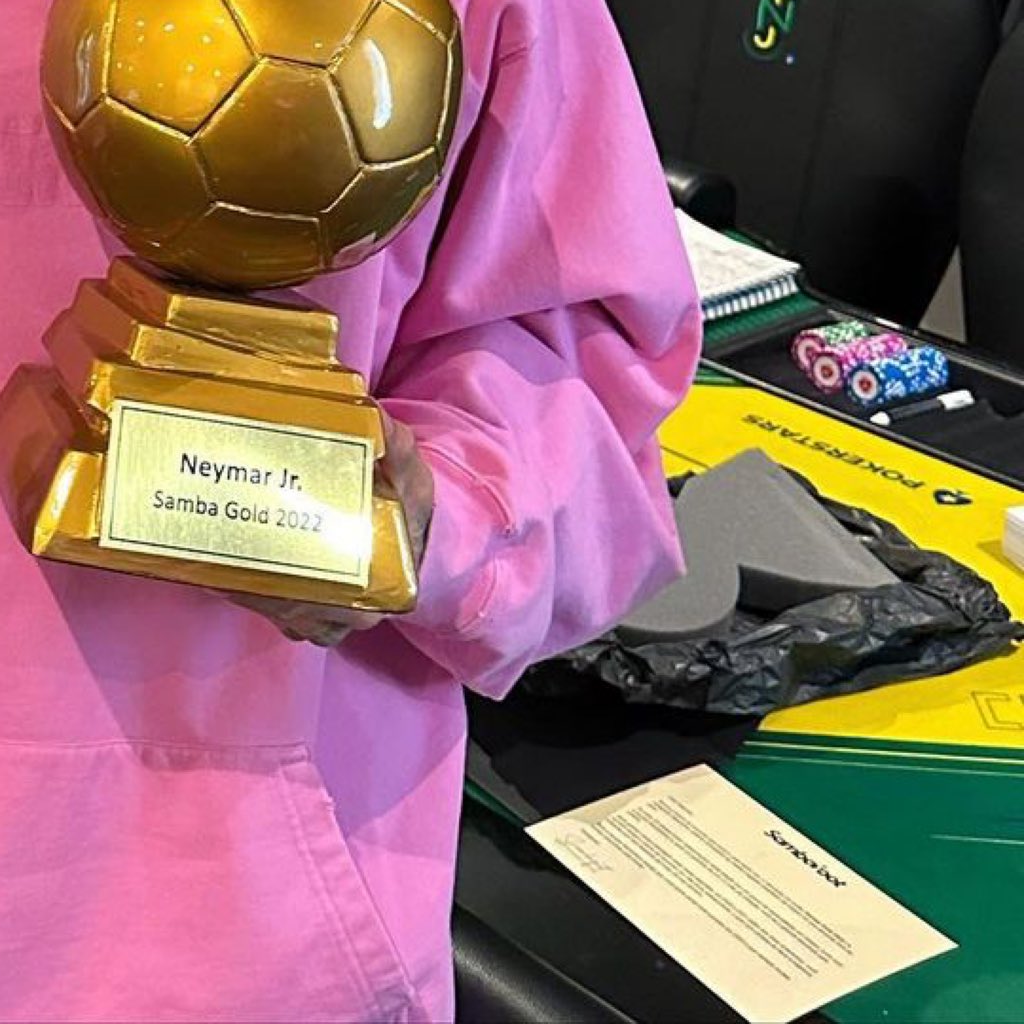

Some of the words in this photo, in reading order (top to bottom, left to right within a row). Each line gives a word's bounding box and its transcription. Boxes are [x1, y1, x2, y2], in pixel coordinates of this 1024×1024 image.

[180, 452, 272, 484] Neymar
[279, 468, 303, 491] Jr.
[743, 414, 925, 490] POKERSTARS
[153, 490, 219, 517] Samba
[225, 501, 269, 524] Gold
[275, 508, 323, 533] 2022
